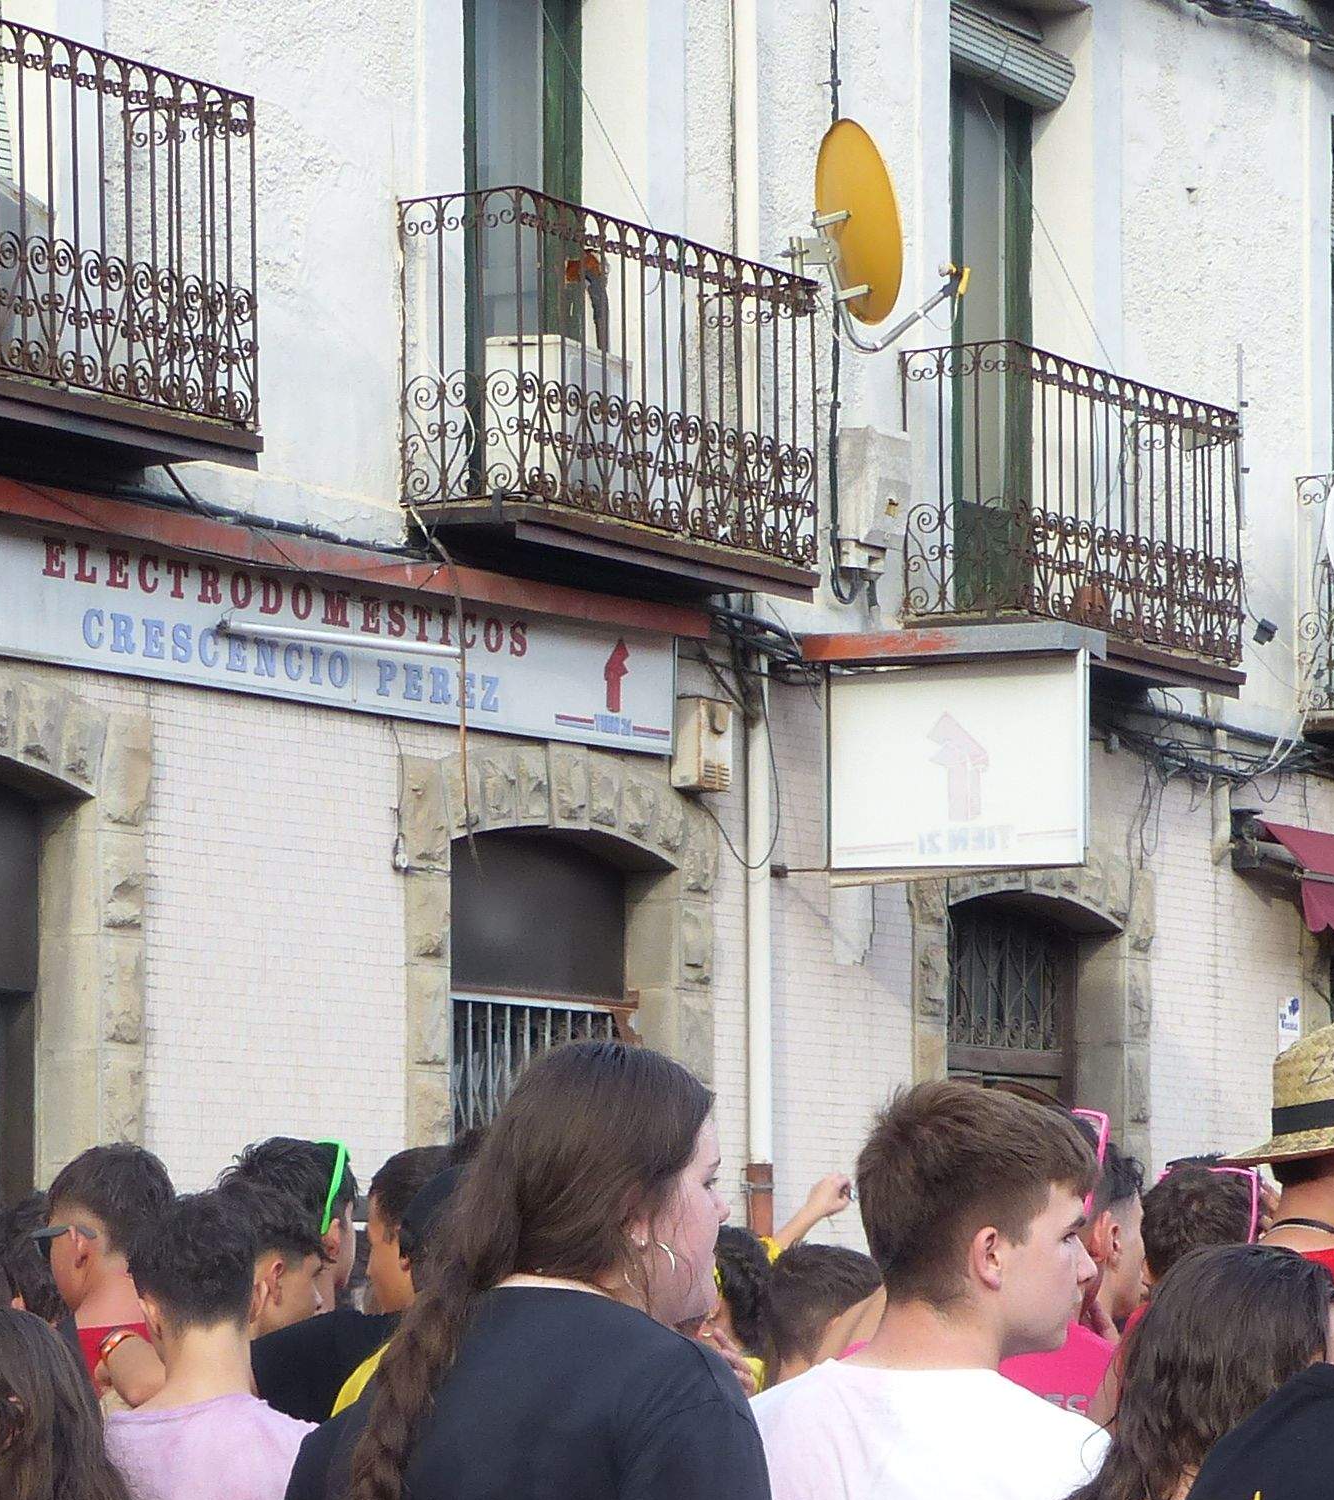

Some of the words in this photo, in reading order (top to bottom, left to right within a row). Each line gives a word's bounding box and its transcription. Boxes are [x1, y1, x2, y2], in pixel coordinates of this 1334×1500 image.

[42, 536, 529, 658] ELECTRODOMESTICOS
[82, 607, 352, 689] CRESCENCIO
[376, 658, 499, 712] PEREZ
